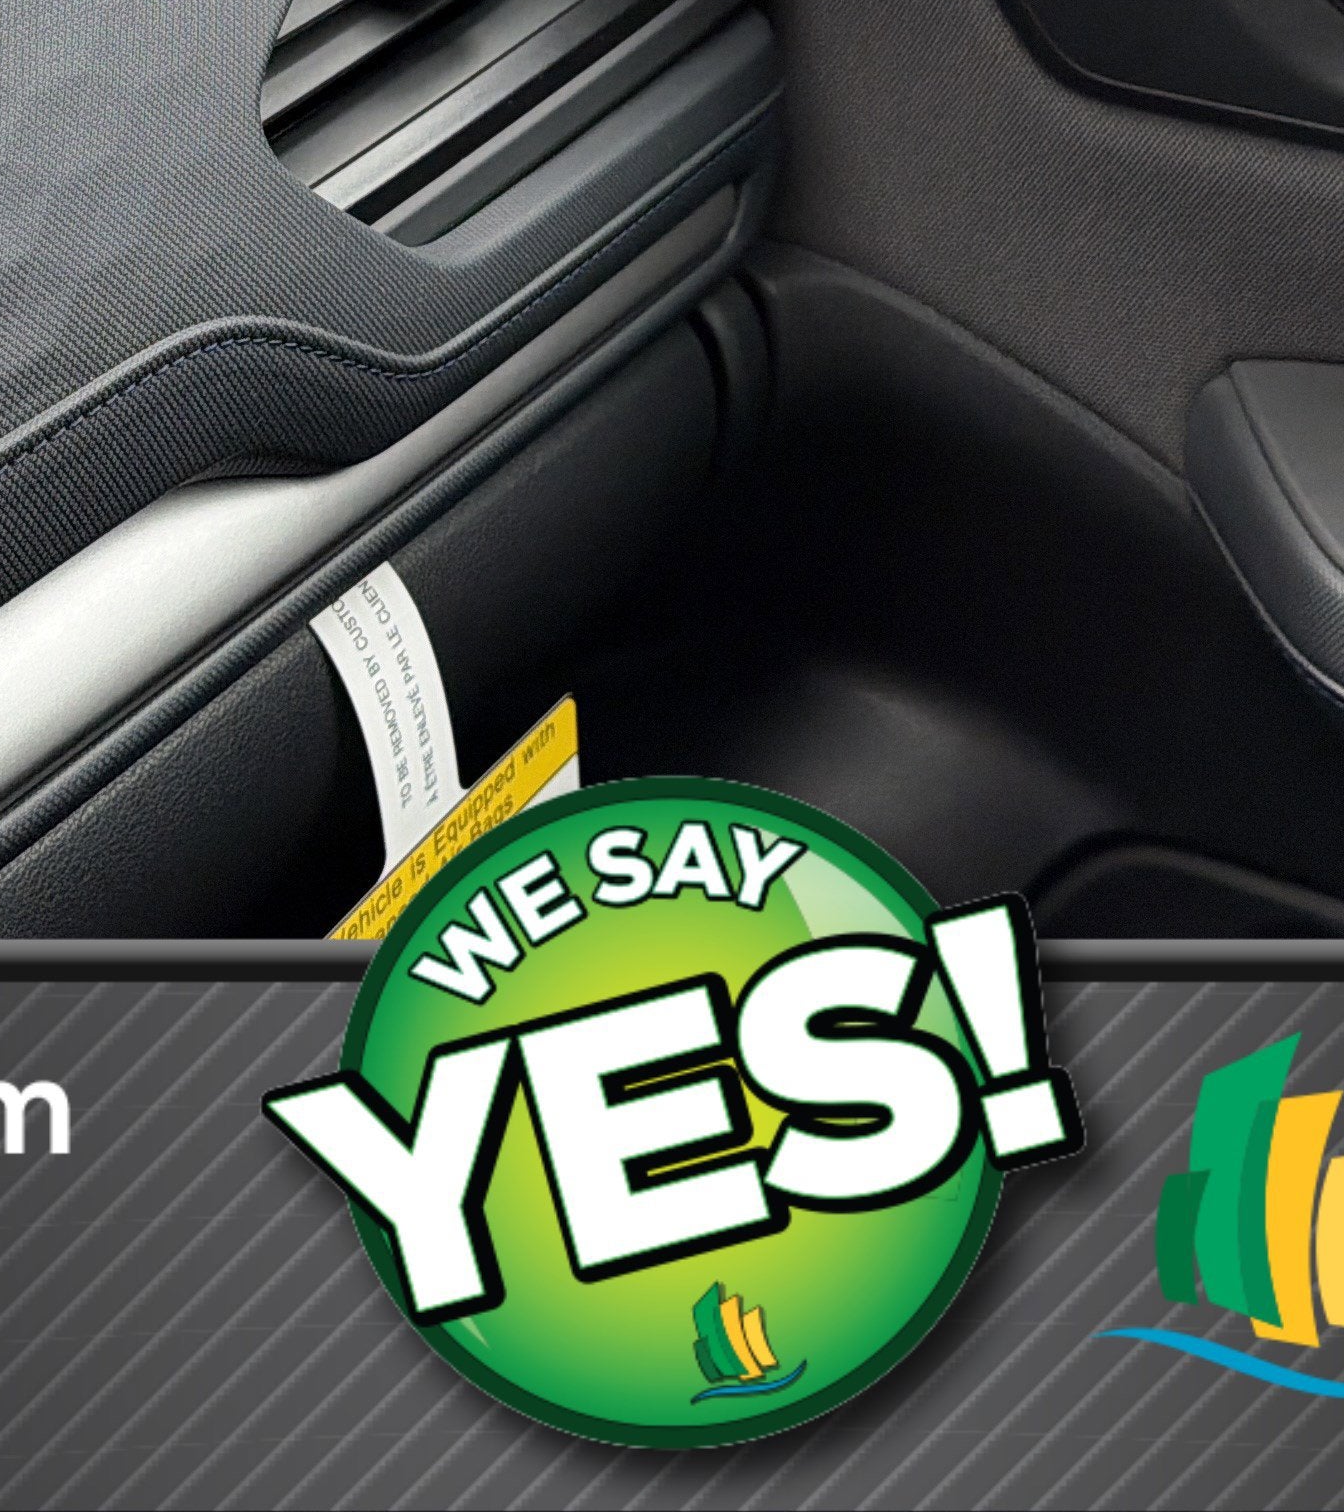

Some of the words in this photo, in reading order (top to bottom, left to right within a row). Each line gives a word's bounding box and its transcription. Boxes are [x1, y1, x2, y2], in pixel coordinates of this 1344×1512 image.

[386, 623, 404, 650] LE
[363, 654, 381, 678] BY
[396, 648, 416, 685] PAR
[374, 678, 404, 757] REMOVED
[396, 757, 409, 783] BE
[400, 783, 412, 808] TO
[409, 851, 426, 880] is
[433, 757, 516, 856] Equipped
[521, 721, 556, 764] with
